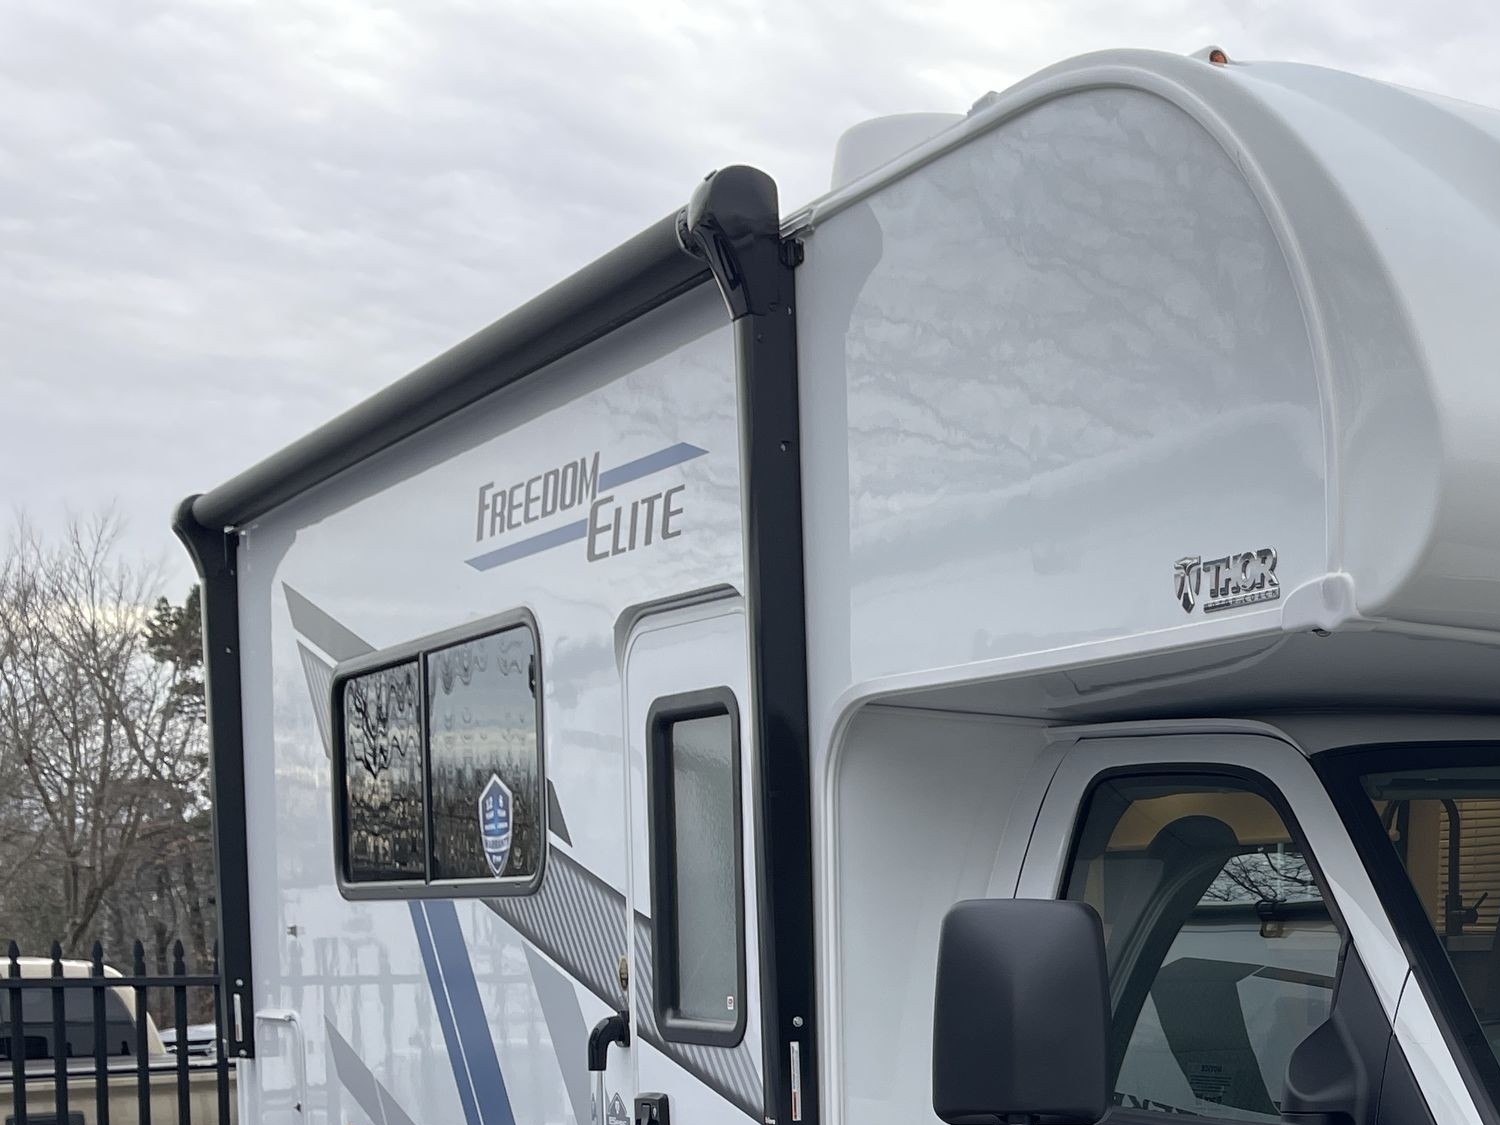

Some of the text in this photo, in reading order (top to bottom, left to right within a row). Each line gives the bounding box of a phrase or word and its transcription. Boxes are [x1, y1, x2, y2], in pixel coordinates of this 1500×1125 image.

[476, 450, 600, 543] FREEDOM
[586, 483, 686, 563] ELITE
[1202, 547, 1280, 599] THOR
